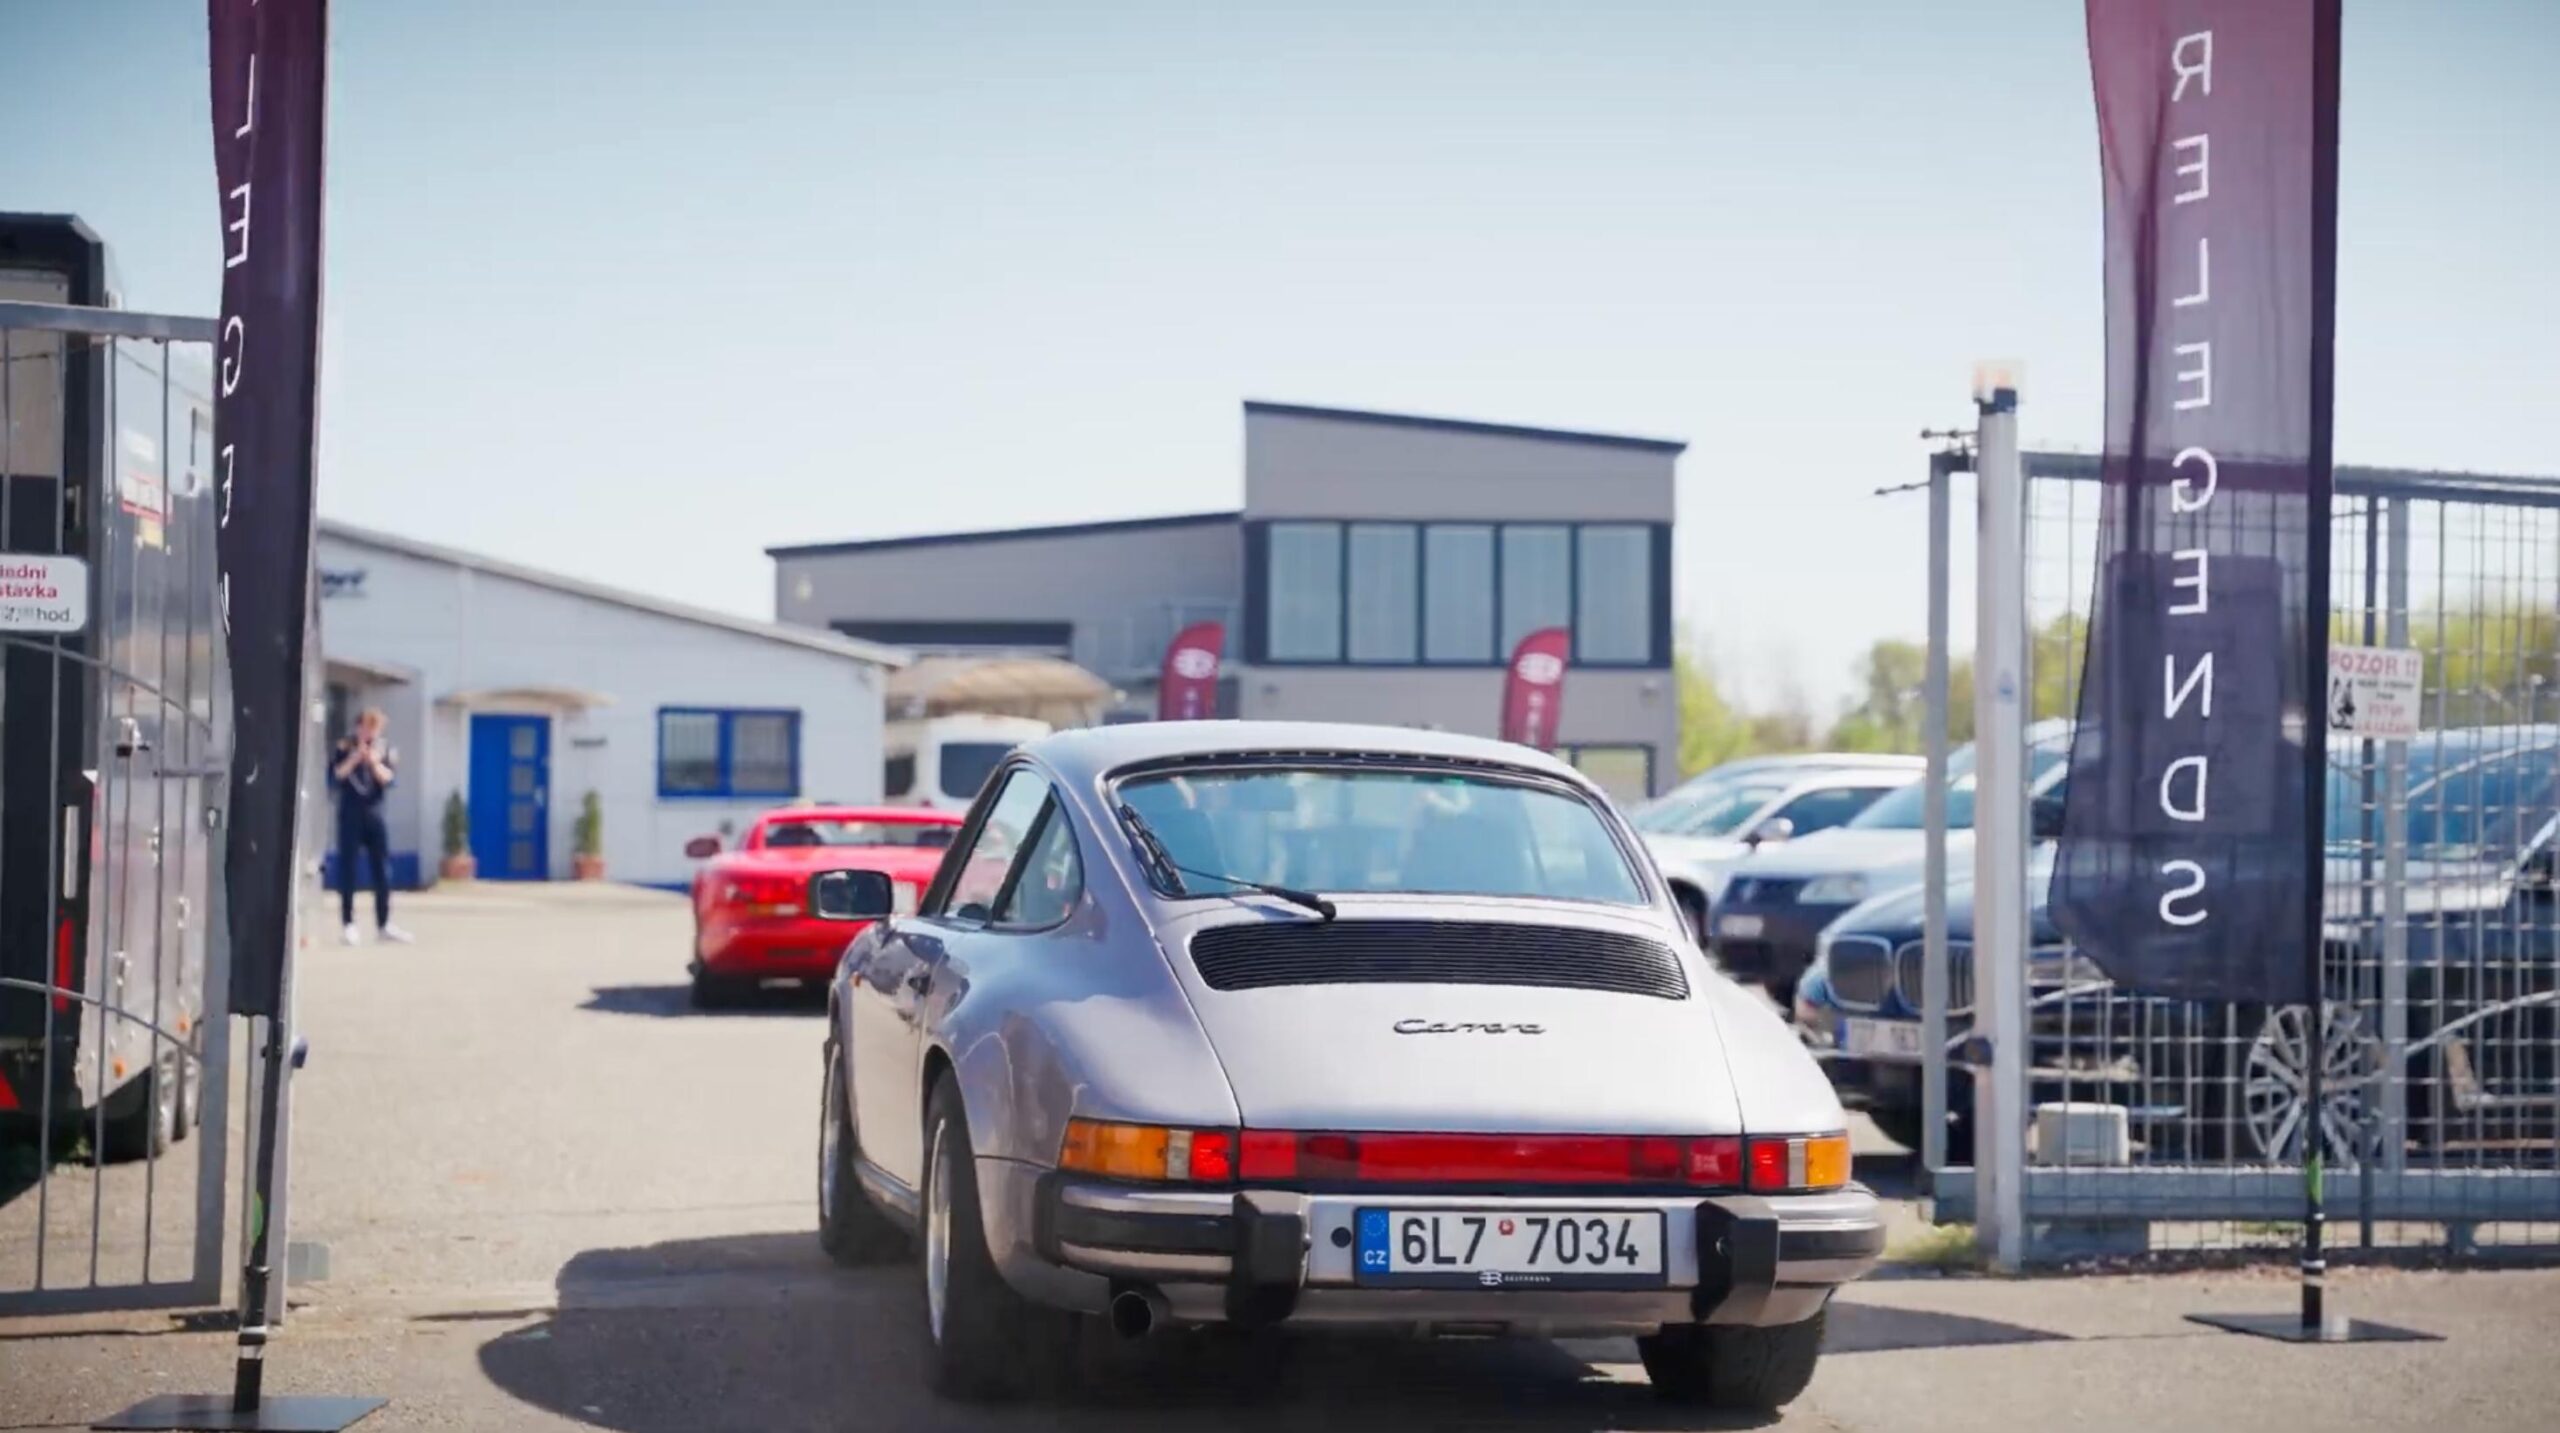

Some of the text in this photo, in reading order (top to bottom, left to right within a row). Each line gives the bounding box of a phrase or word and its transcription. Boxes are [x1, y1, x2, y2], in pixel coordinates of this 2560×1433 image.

[1393, 1019, 1547, 1034] Carrera
[1402, 1217, 1639, 1266] 6L7 7034
[1364, 1250, 1387, 1265] CZ
